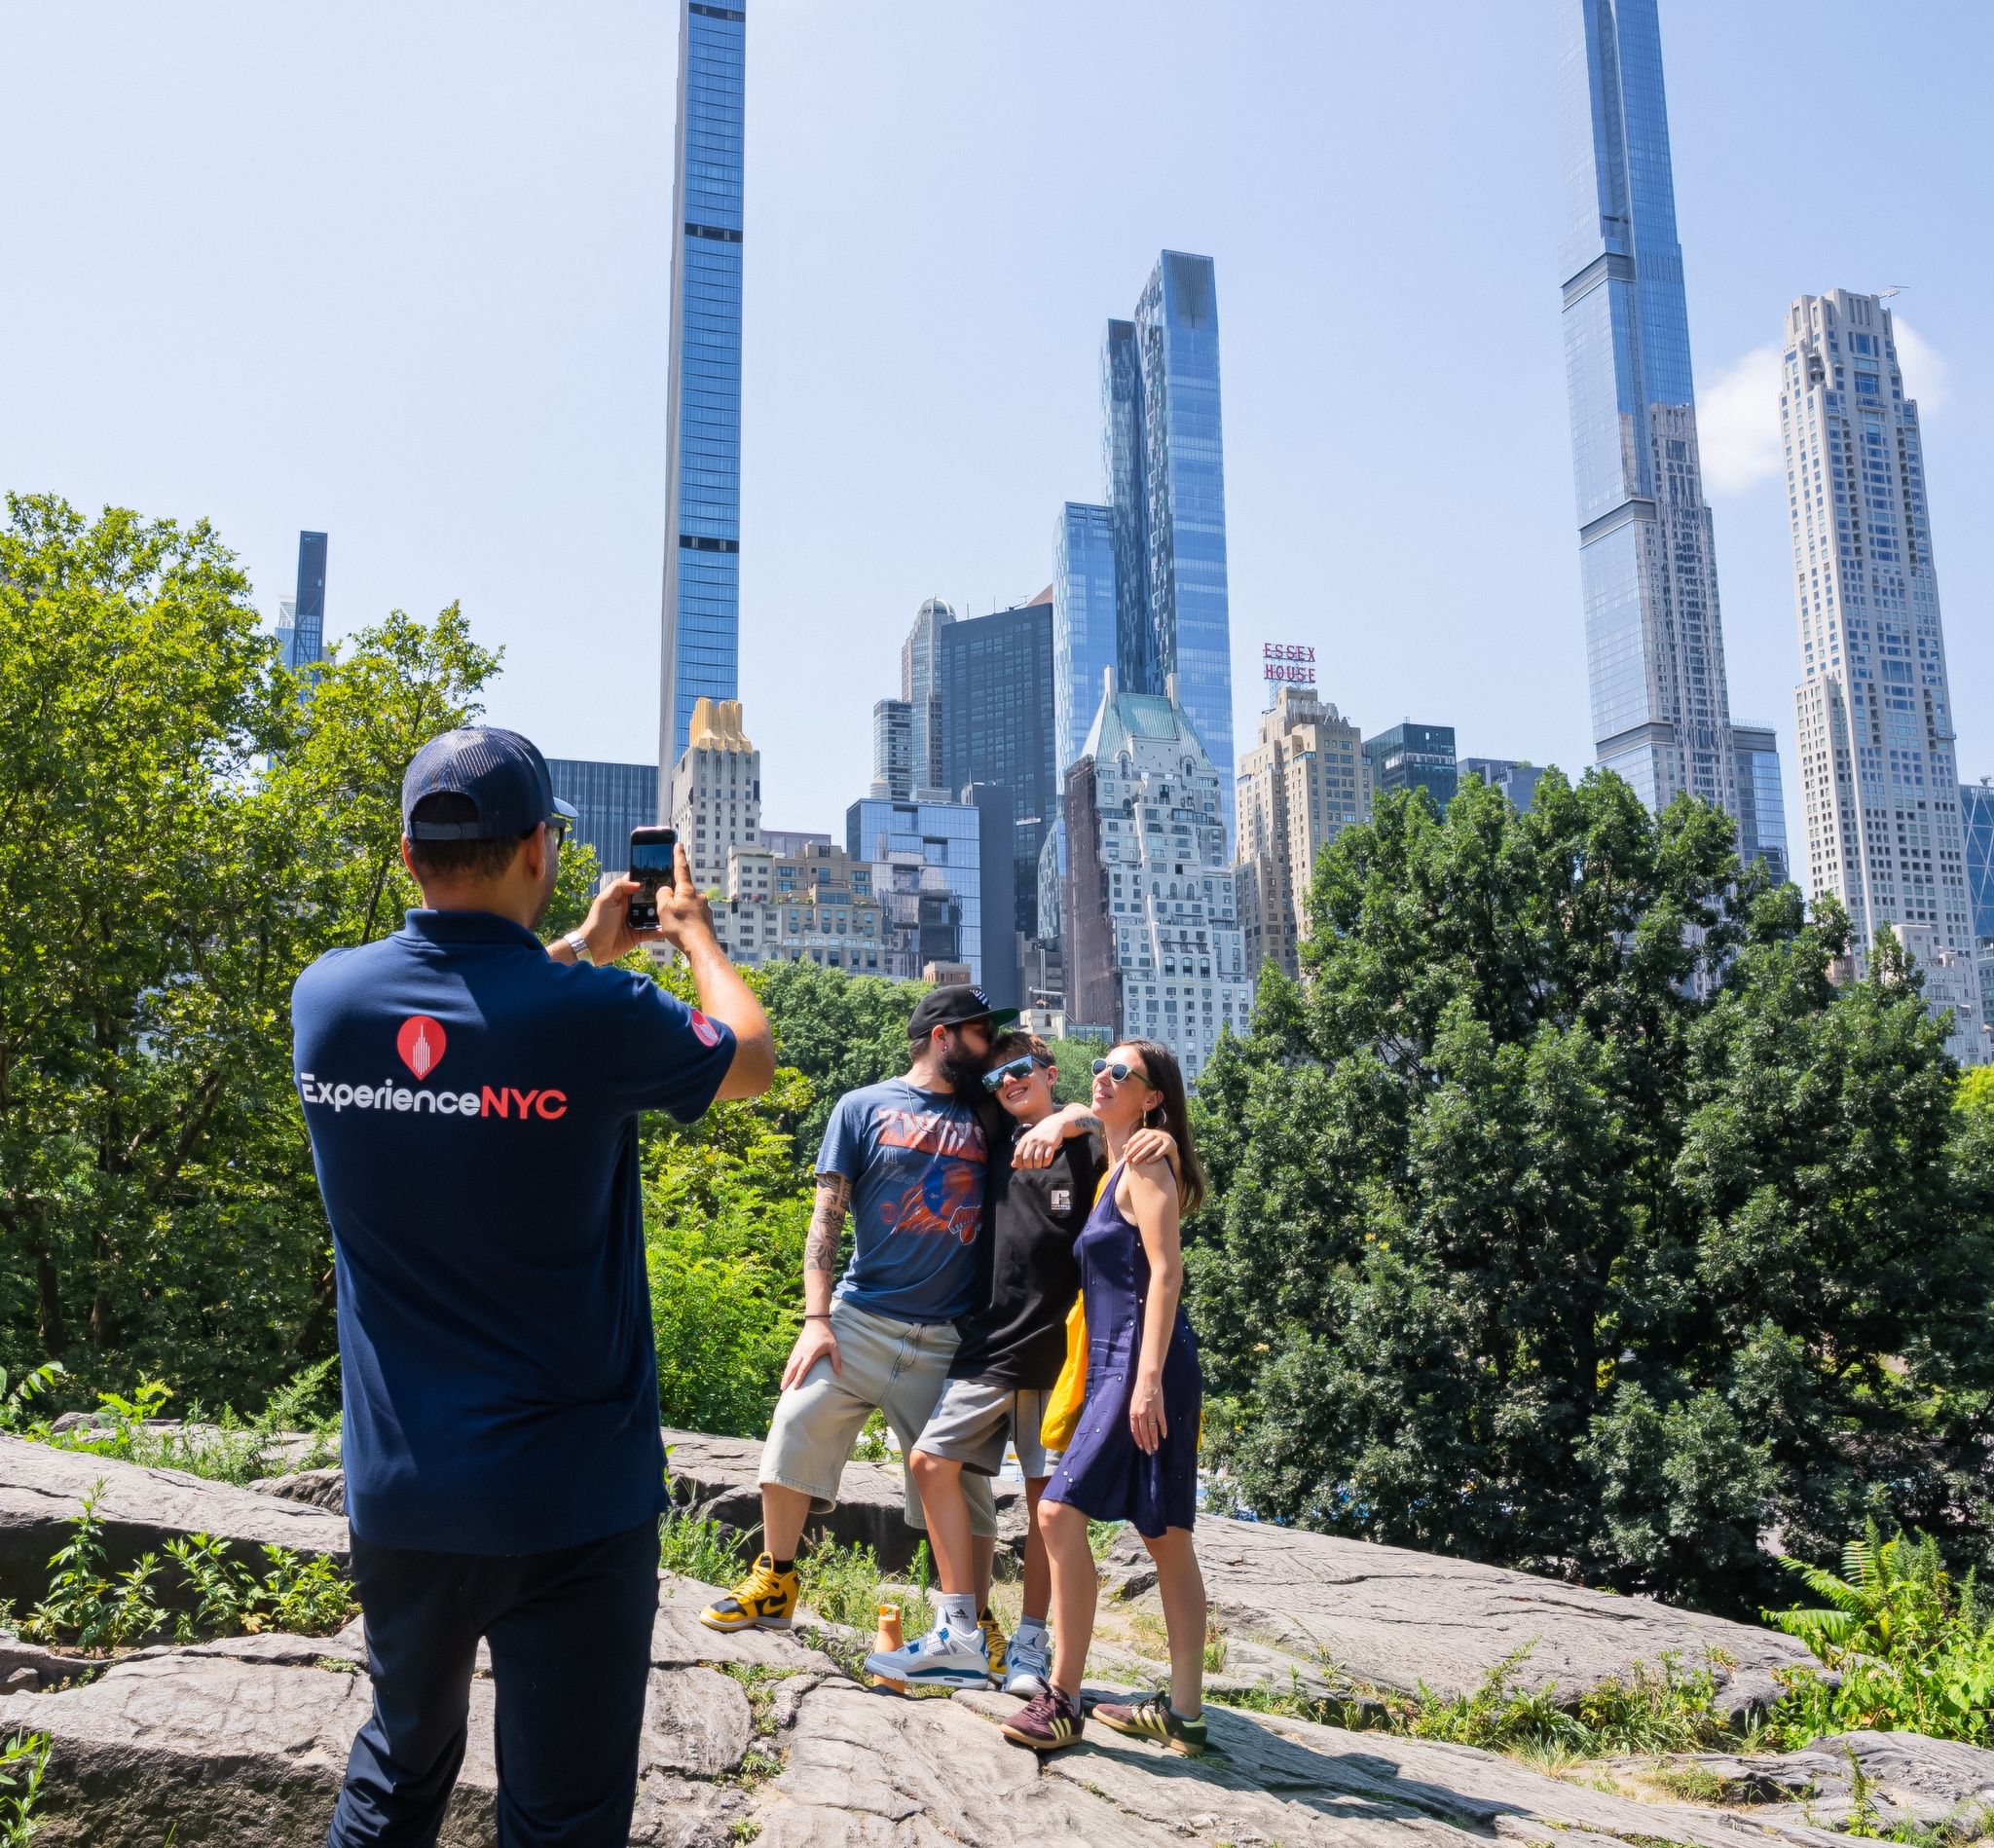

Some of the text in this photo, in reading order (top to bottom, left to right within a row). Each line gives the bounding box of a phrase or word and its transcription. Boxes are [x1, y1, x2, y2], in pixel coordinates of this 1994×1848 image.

[1265, 643, 1315, 662] ESSEX
[1266, 664, 1315, 684] HOUSE
[301, 1072, 568, 1120] ExperienceNYC
